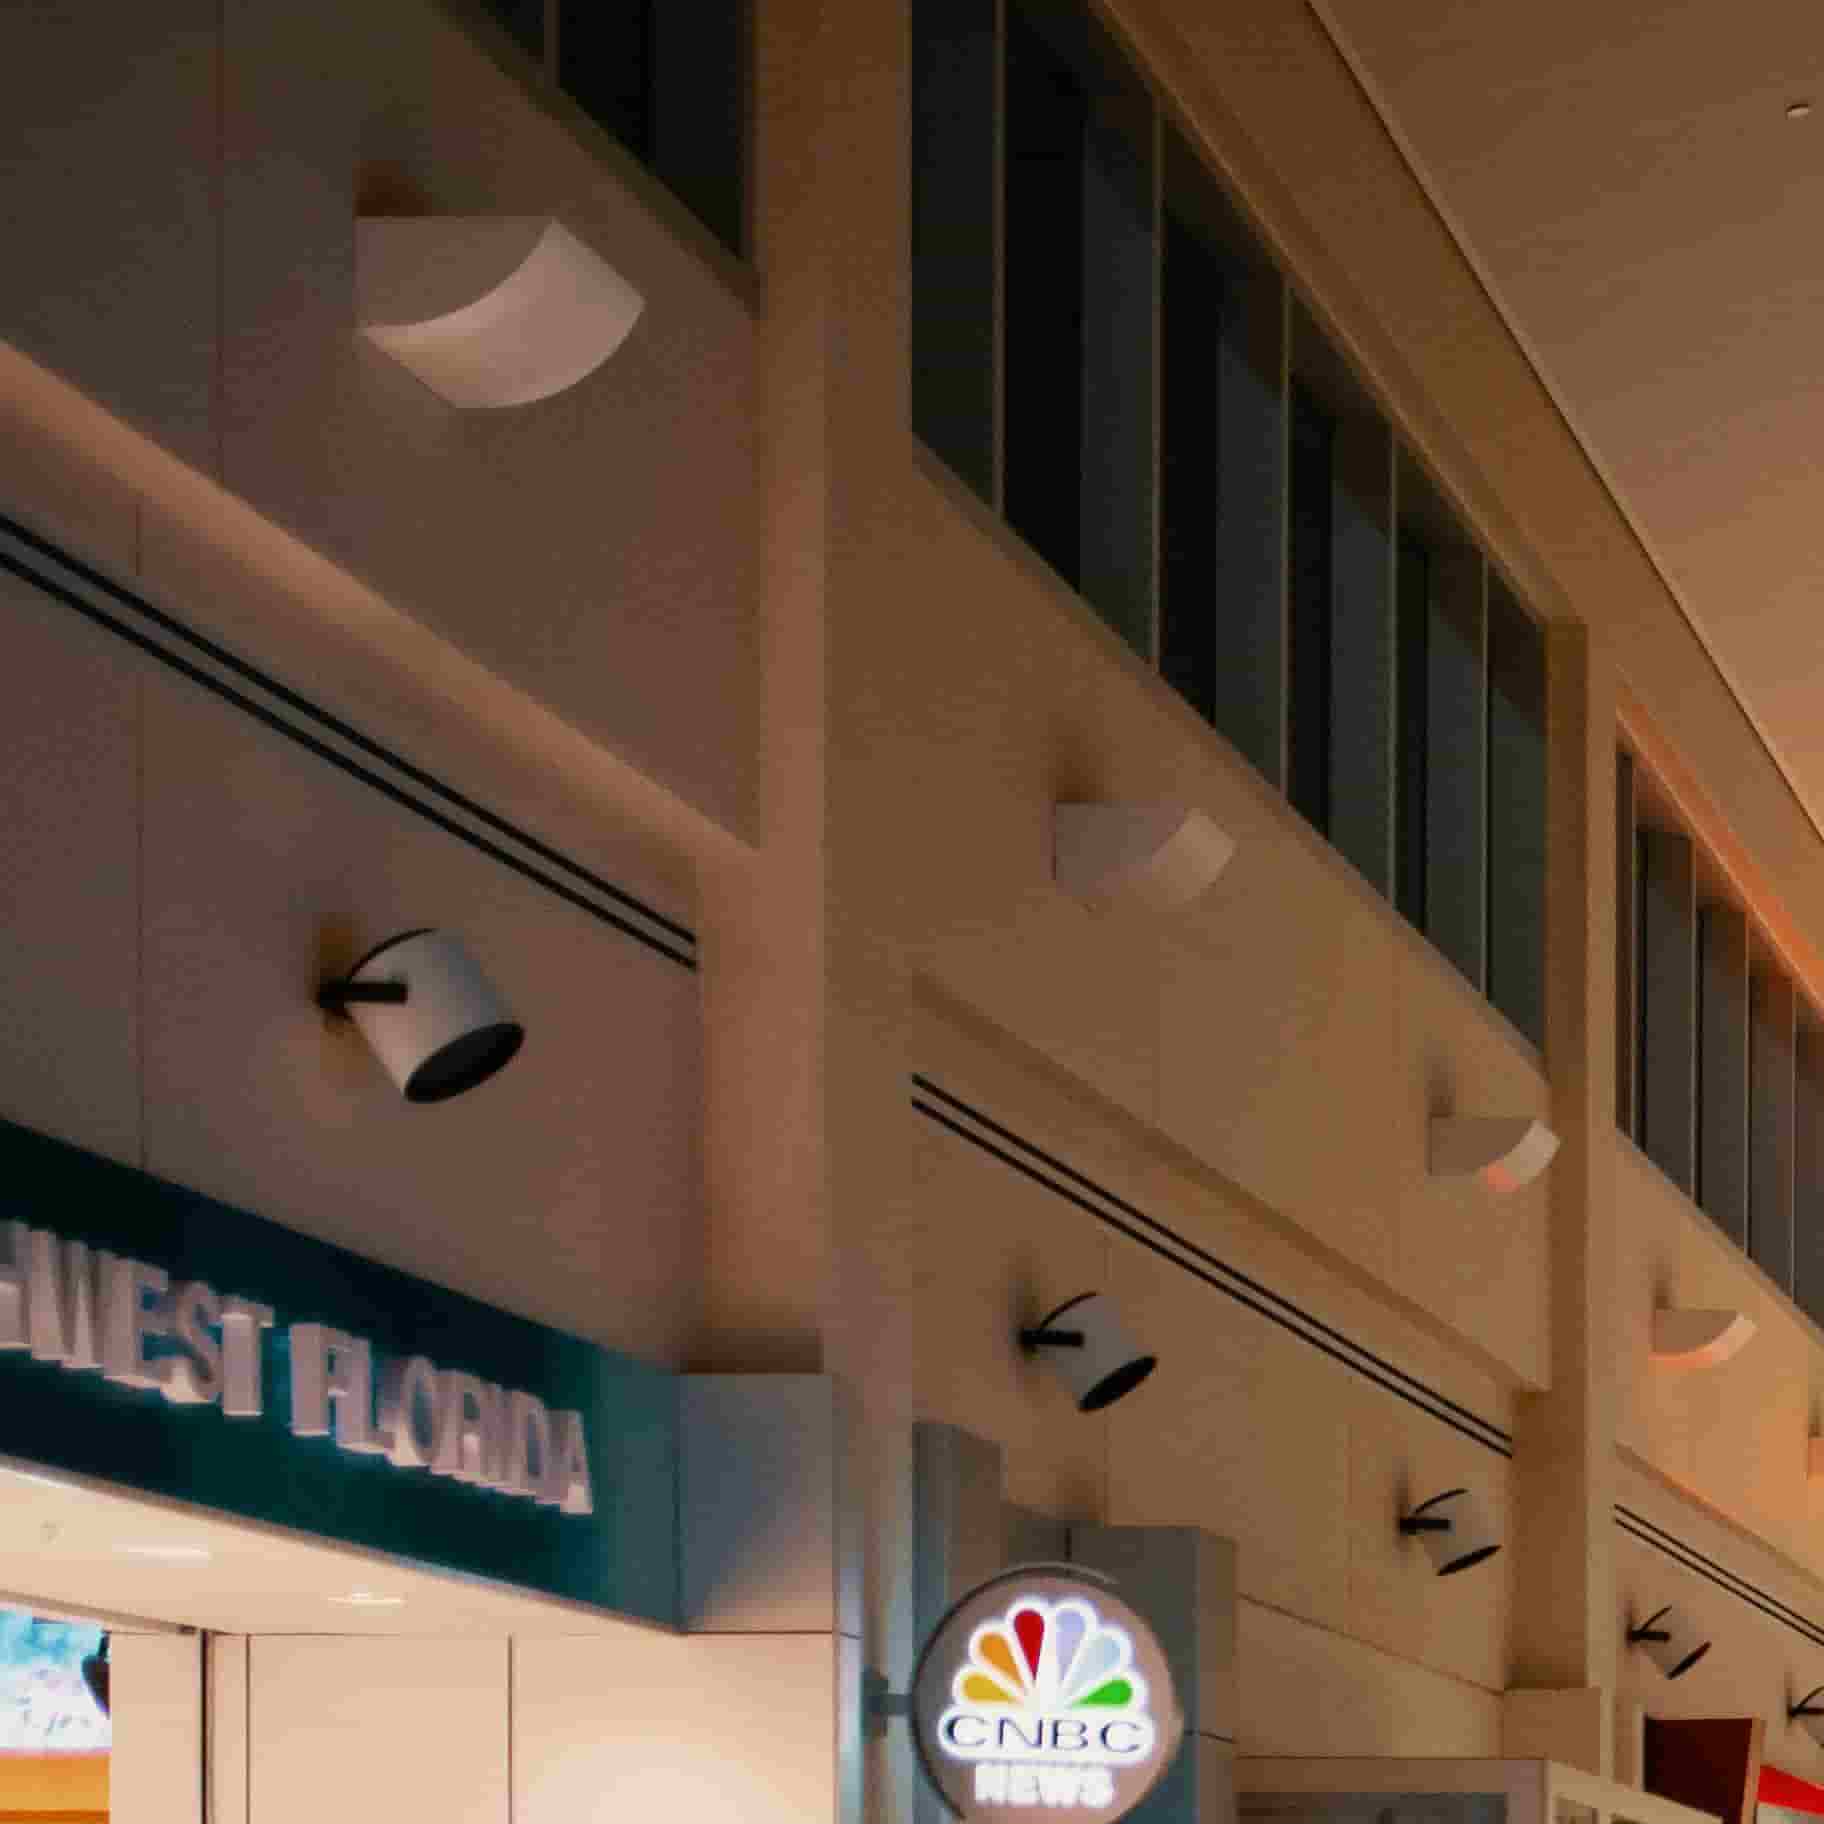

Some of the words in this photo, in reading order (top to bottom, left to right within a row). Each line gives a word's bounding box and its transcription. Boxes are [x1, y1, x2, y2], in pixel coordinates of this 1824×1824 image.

[289, 1321, 593, 1514] FLORIDA
[946, 1713, 1142, 1753] CNBC
[974, 1762, 1114, 1808] NEWS
